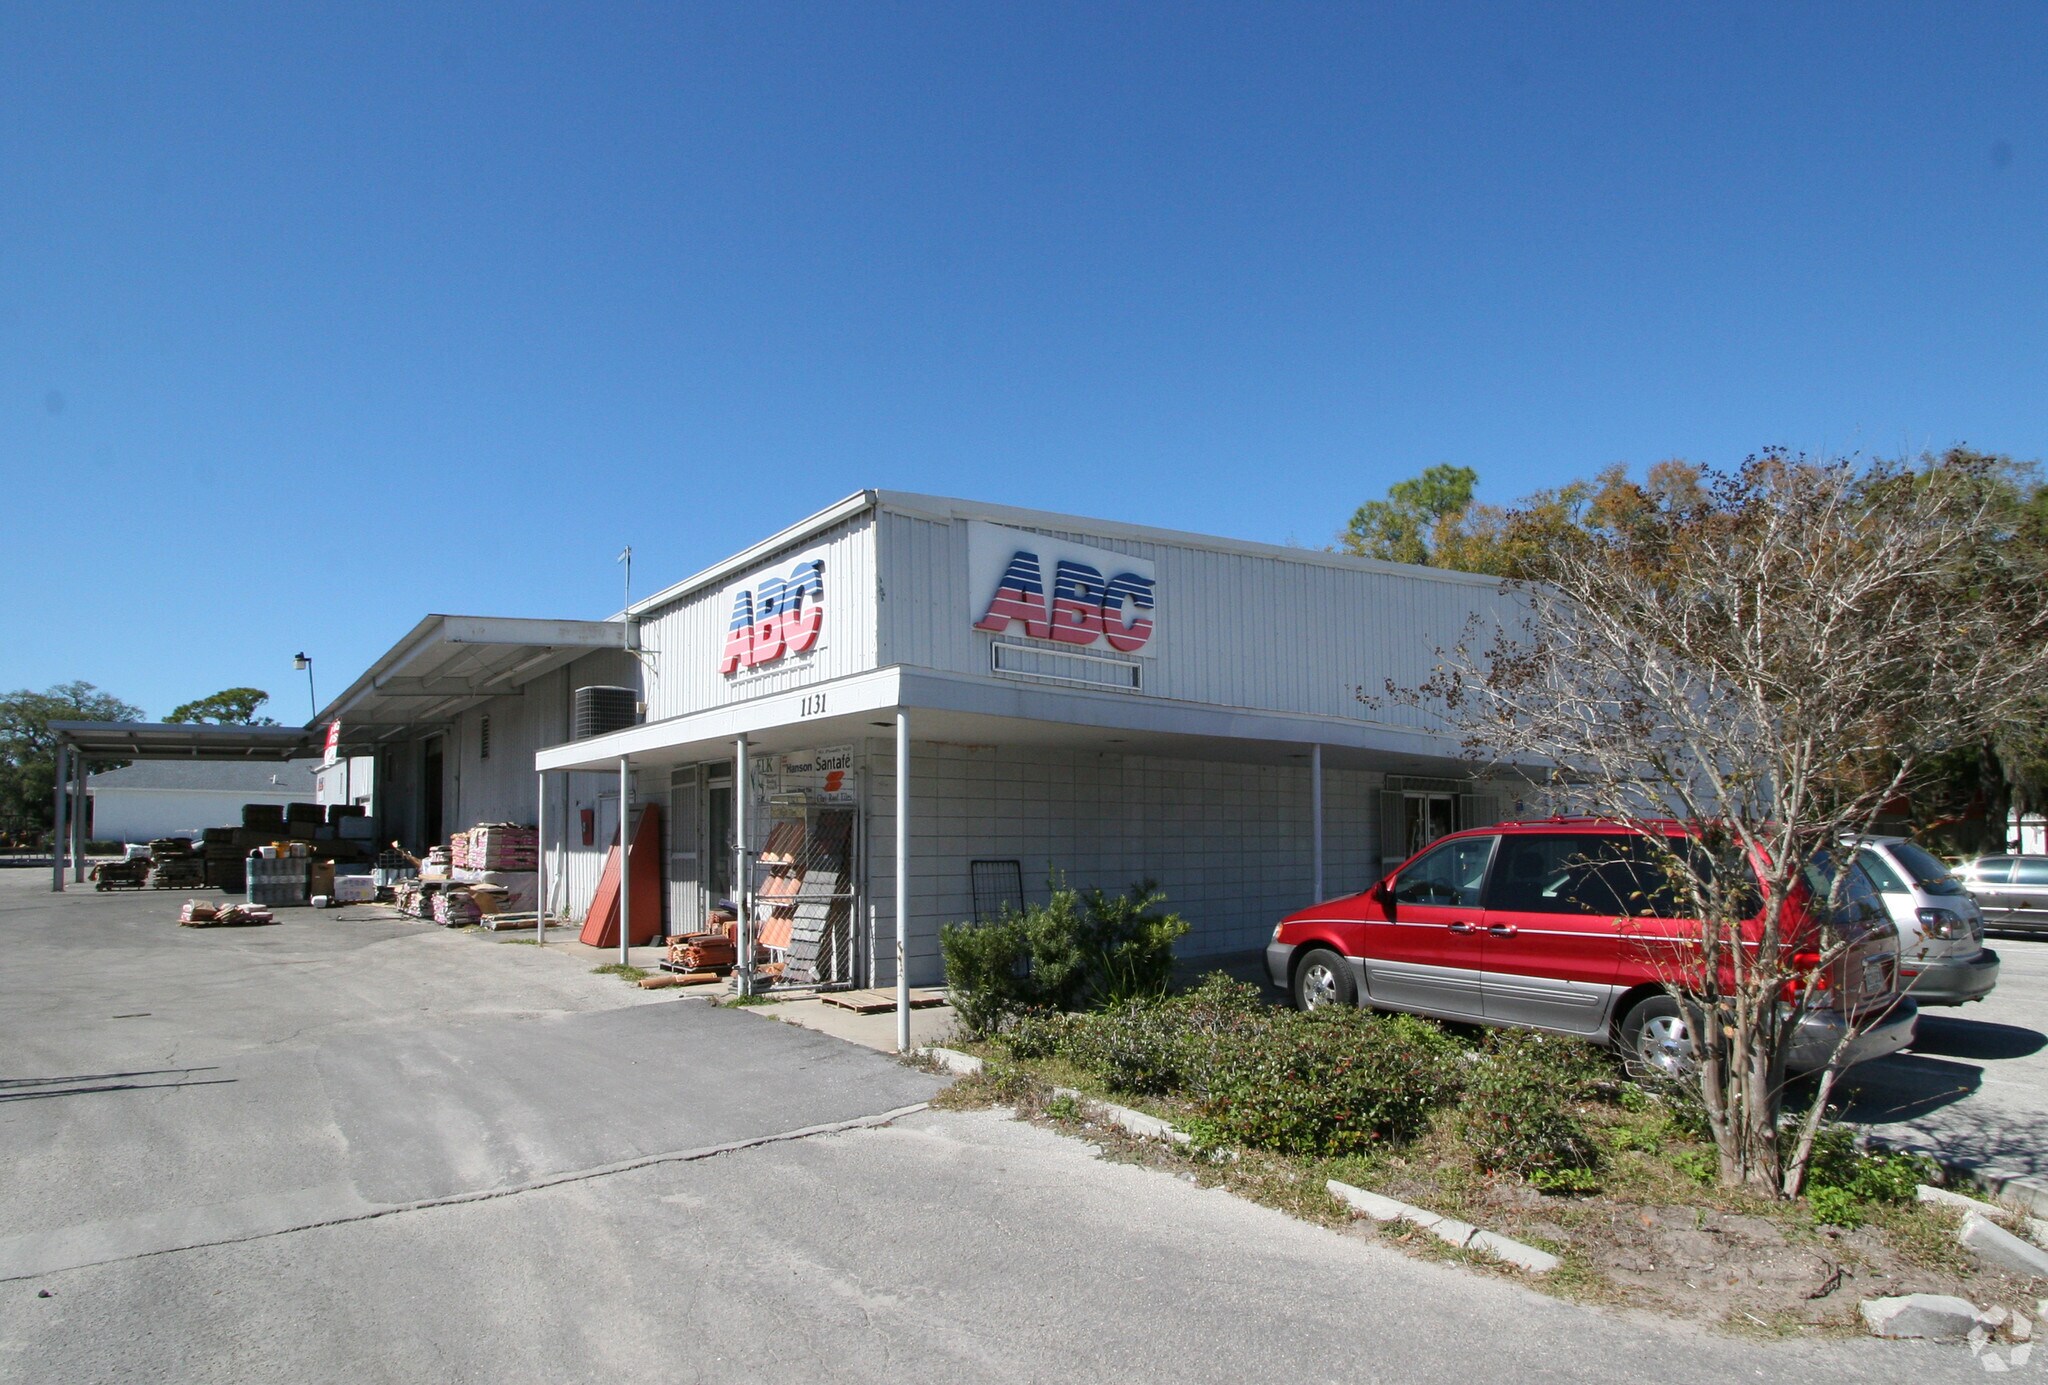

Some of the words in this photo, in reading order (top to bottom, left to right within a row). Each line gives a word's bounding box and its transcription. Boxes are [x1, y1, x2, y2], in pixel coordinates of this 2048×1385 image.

[973, 550, 1156, 652] ABC
[718, 558, 824, 674] ABC
[800, 692, 826, 718] 1131
[785, 763, 813, 774] Hanson
[815, 753, 851, 771] Santafé
